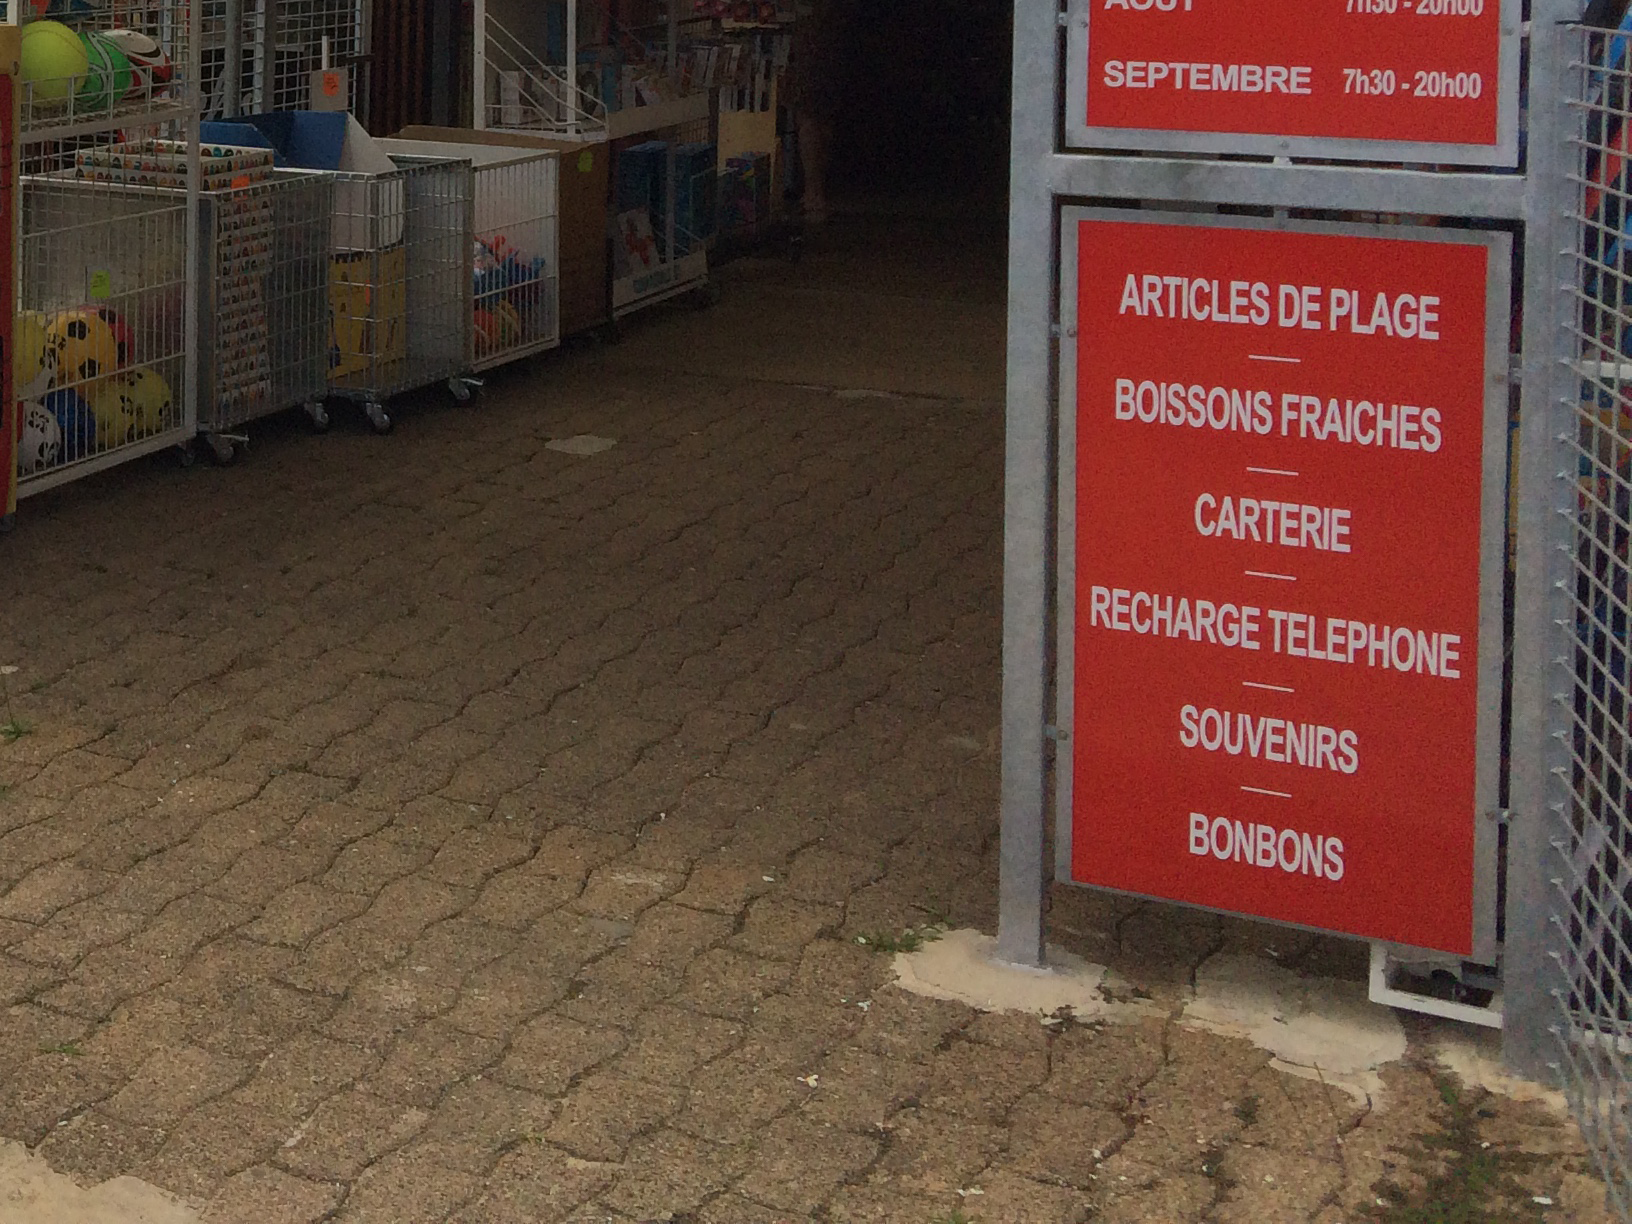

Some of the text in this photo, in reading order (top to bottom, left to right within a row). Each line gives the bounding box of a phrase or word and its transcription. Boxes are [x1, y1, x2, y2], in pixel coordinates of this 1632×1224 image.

[1104, 60, 1311, 94] SEPTEMBRE
[1120, 274, 1439, 340] ARTICLES DE PLAGE
[1116, 379, 1441, 452] BOISSONS FRAICHES
[1195, 493, 1350, 552] CARTERIE
[1091, 586, 1460, 678] RECHARGE TELEPHONE
[1180, 705, 1358, 773] SOUVENIRS
[1190, 813, 1343, 880] BONBONS
